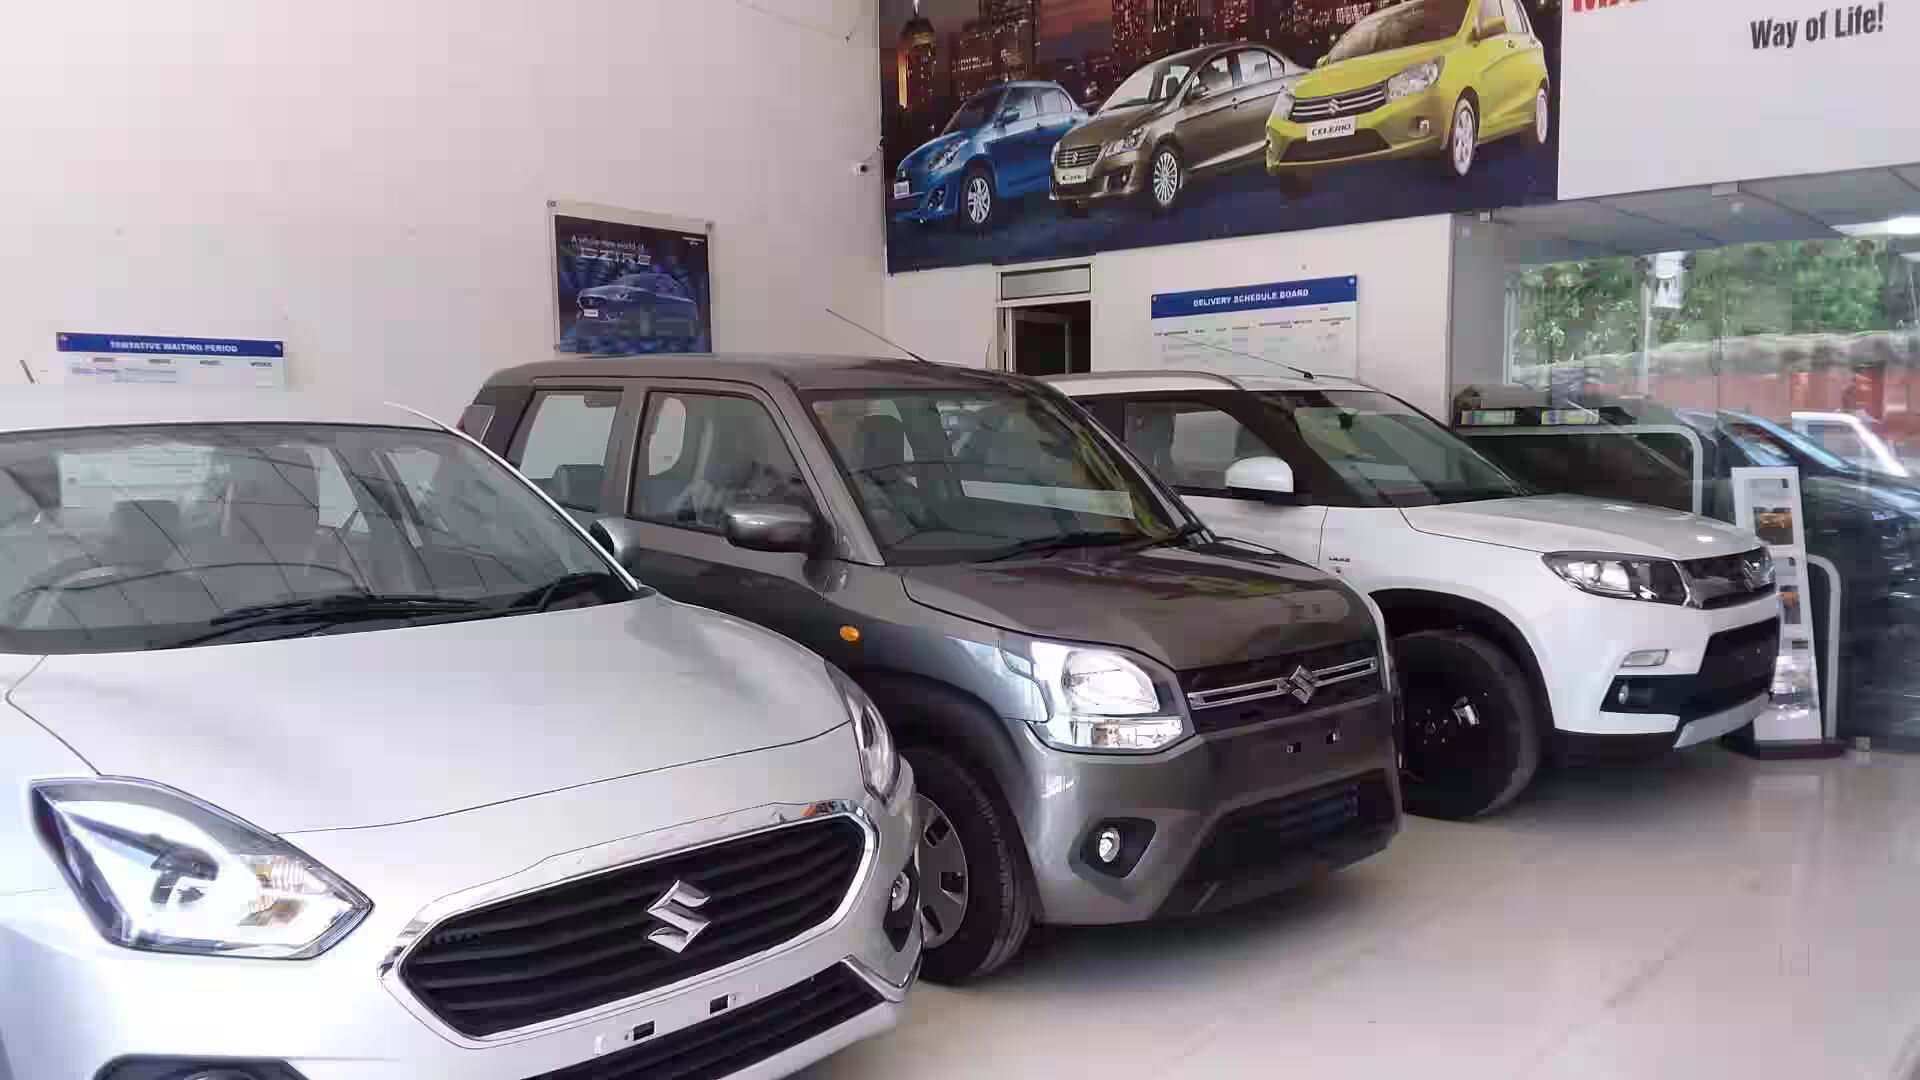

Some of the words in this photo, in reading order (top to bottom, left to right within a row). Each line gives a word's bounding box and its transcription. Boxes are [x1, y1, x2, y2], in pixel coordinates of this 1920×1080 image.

[1750, 19, 1799, 49] Way
[1806, 10, 1827, 42] of
[1835, 1, 1884, 38] Life!
[1193, 296, 1232, 307] DELIVERY
[1234, 292, 1278, 304] SCHEDULE
[1280, 288, 1309, 299] BOARD
[110, 341, 161, 350] TENTATIVE
[163, 343, 203, 351] WAITING
[205, 344, 239, 353] PERIOD
